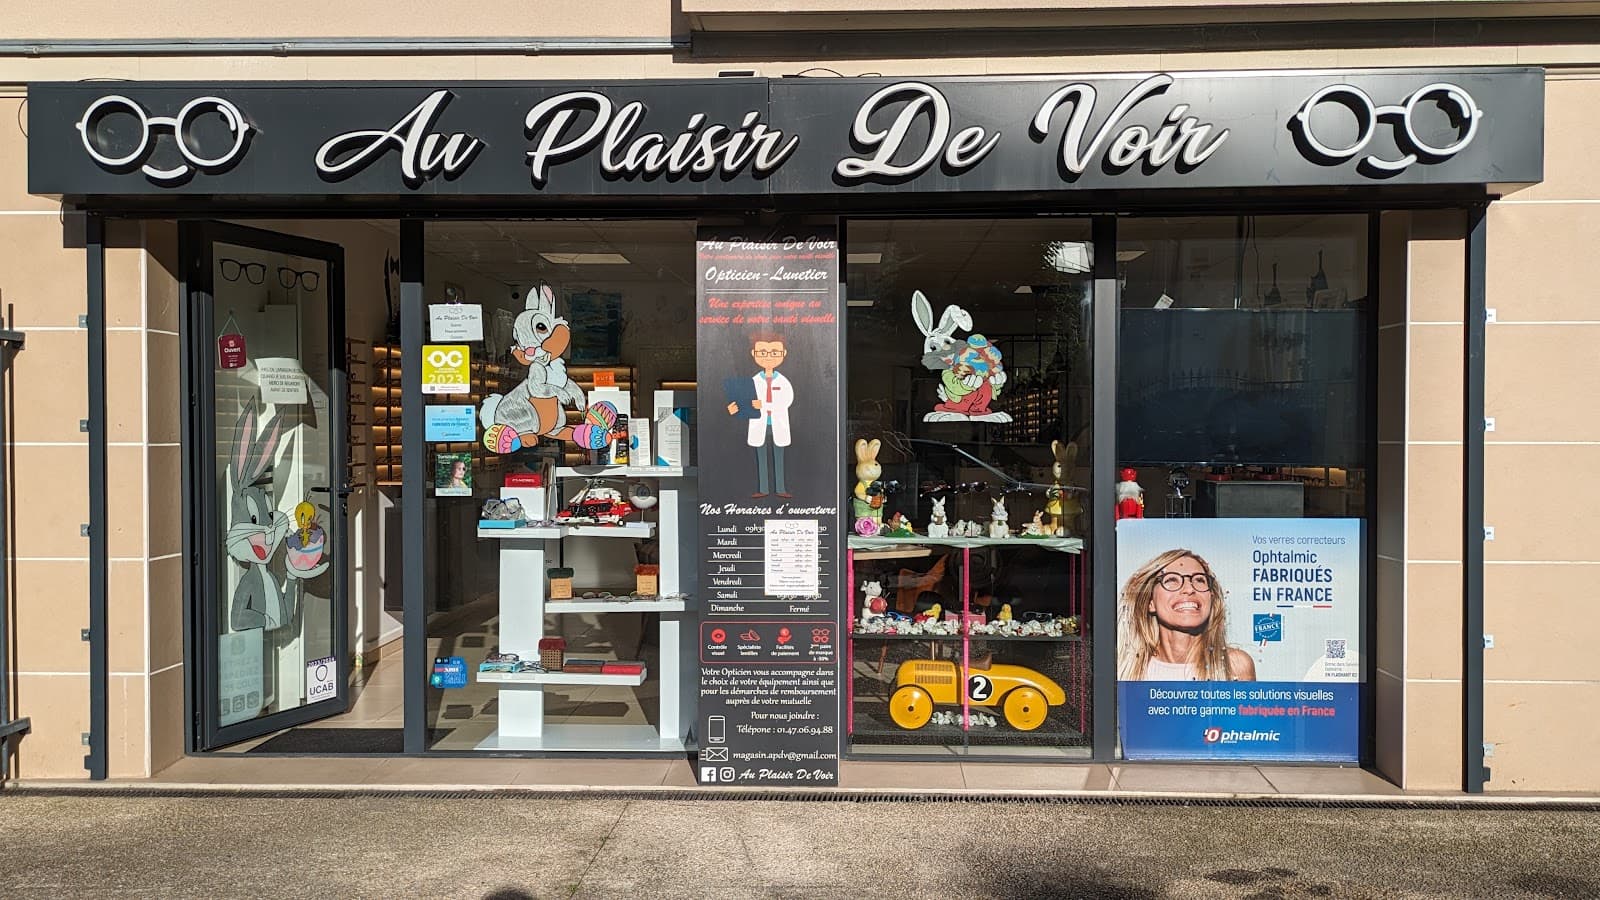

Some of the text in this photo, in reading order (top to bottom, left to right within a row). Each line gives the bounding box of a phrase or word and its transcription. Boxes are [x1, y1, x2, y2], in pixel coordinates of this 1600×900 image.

[315, 74, 1230, 183] Au Plaisir De Voir
[700, 236, 836, 251] Au Plaisir De Voir
[428, 374, 464, 384] 2023
[700, 503, 837, 515] Nos Horaires d'ouverture
[717, 524, 737, 533] Lundi
[717, 538, 738, 546] Mardi
[1252, 536, 1346, 545] Vos verres correcteurs
[712, 550, 742, 559] Mercredi
[1253, 550, 1318, 566] Ophtalmic
[717, 563, 736, 574] Jeudi
[1253, 565, 1333, 583] FABRIQUÉS
[713, 576, 742, 586] Vendredi
[717, 590, 738, 599] Samedi
[1253, 587, 1333, 602] EN FRANCE
[711, 603, 744, 612] Dimanche
[701, 668, 721, 676] Votre
[721, 668, 752, 678] Opticien
[771, 670, 815, 678] accompagne
[816, 667, 834, 676] dans
[701, 678, 708, 686] le
[709, 677, 728, 686] choix
[729, 678, 738, 686] de
[758, 677, 800, 688] équipement
[820, 680, 834, 688] que
[973, 676, 987, 698] 2
[310, 682, 334, 696] UCAB
[701, 688, 718, 697] pour
[730, 687, 768, 695] démarches
[770, 687, 779, 695] de
[780, 687, 836, 696] remboursement
[1150, 688, 1334, 701] Découvrez toutes les solutions visuelles
[725, 697, 750, 707] auprès
[751, 697, 760, 705] de
[780, 696, 812, 705] mutuelle
[751, 711, 768, 720] Pour
[787, 710, 815, 722] joindre
[1148, 704, 1335, 718] avec notre gamme fabriquée en France
[776, 726, 834, 736] 01.47.06.94.88
[733, 749, 837, 761] magasin.apdv@gmail.com
[738, 768, 834, 780] Au Plaisir De Voir
